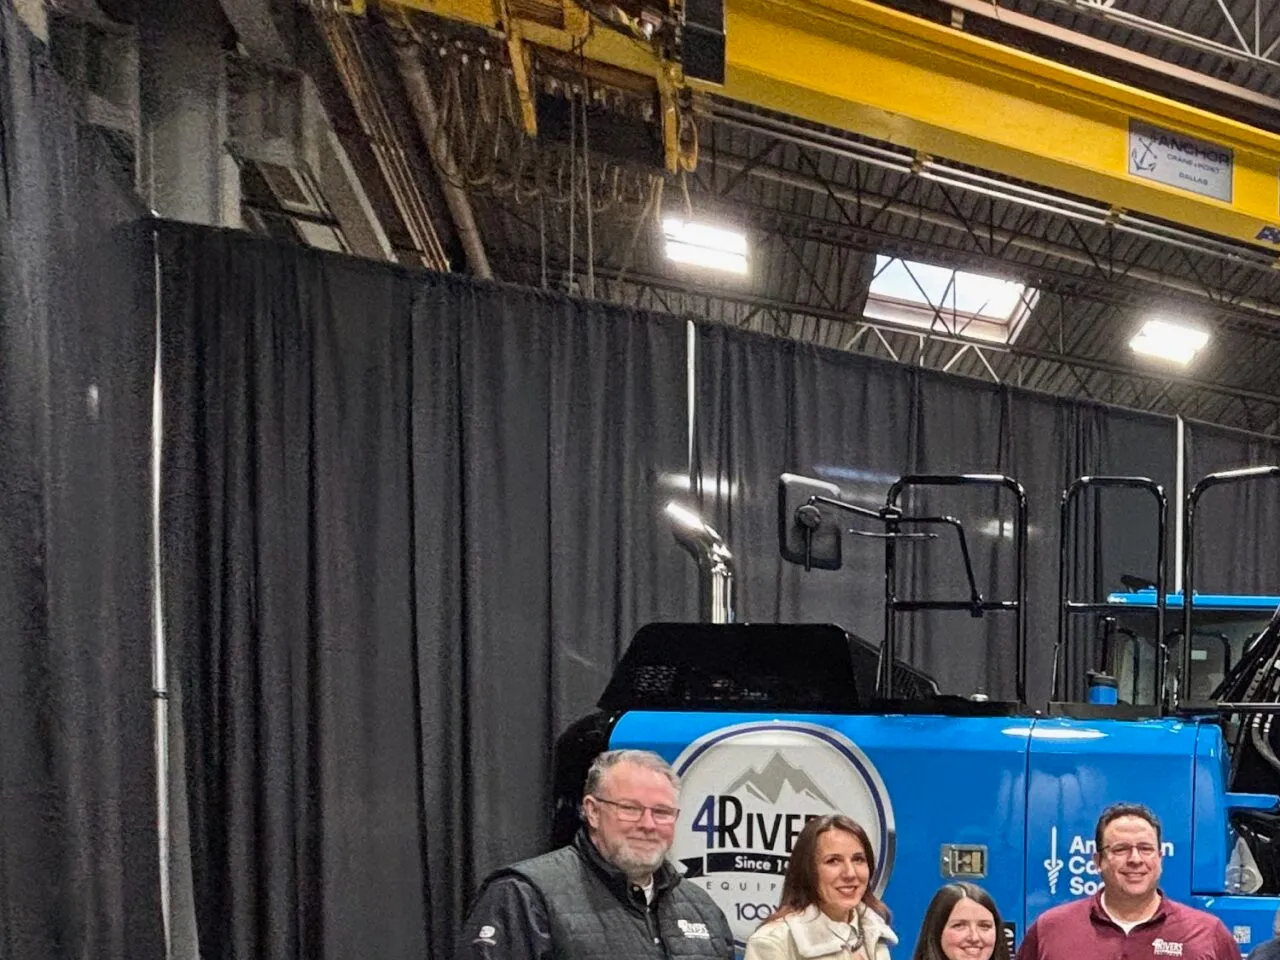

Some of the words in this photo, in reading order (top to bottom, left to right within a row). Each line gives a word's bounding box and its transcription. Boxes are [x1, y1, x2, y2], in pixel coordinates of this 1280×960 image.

[1158, 135, 1231, 166] ANCHOR
[1178, 171, 1209, 186] DALLAS
[691, 795, 820, 853] 4RIVE
[734, 855, 772, 871] Since
[706, 880, 777, 891] EQUIP
